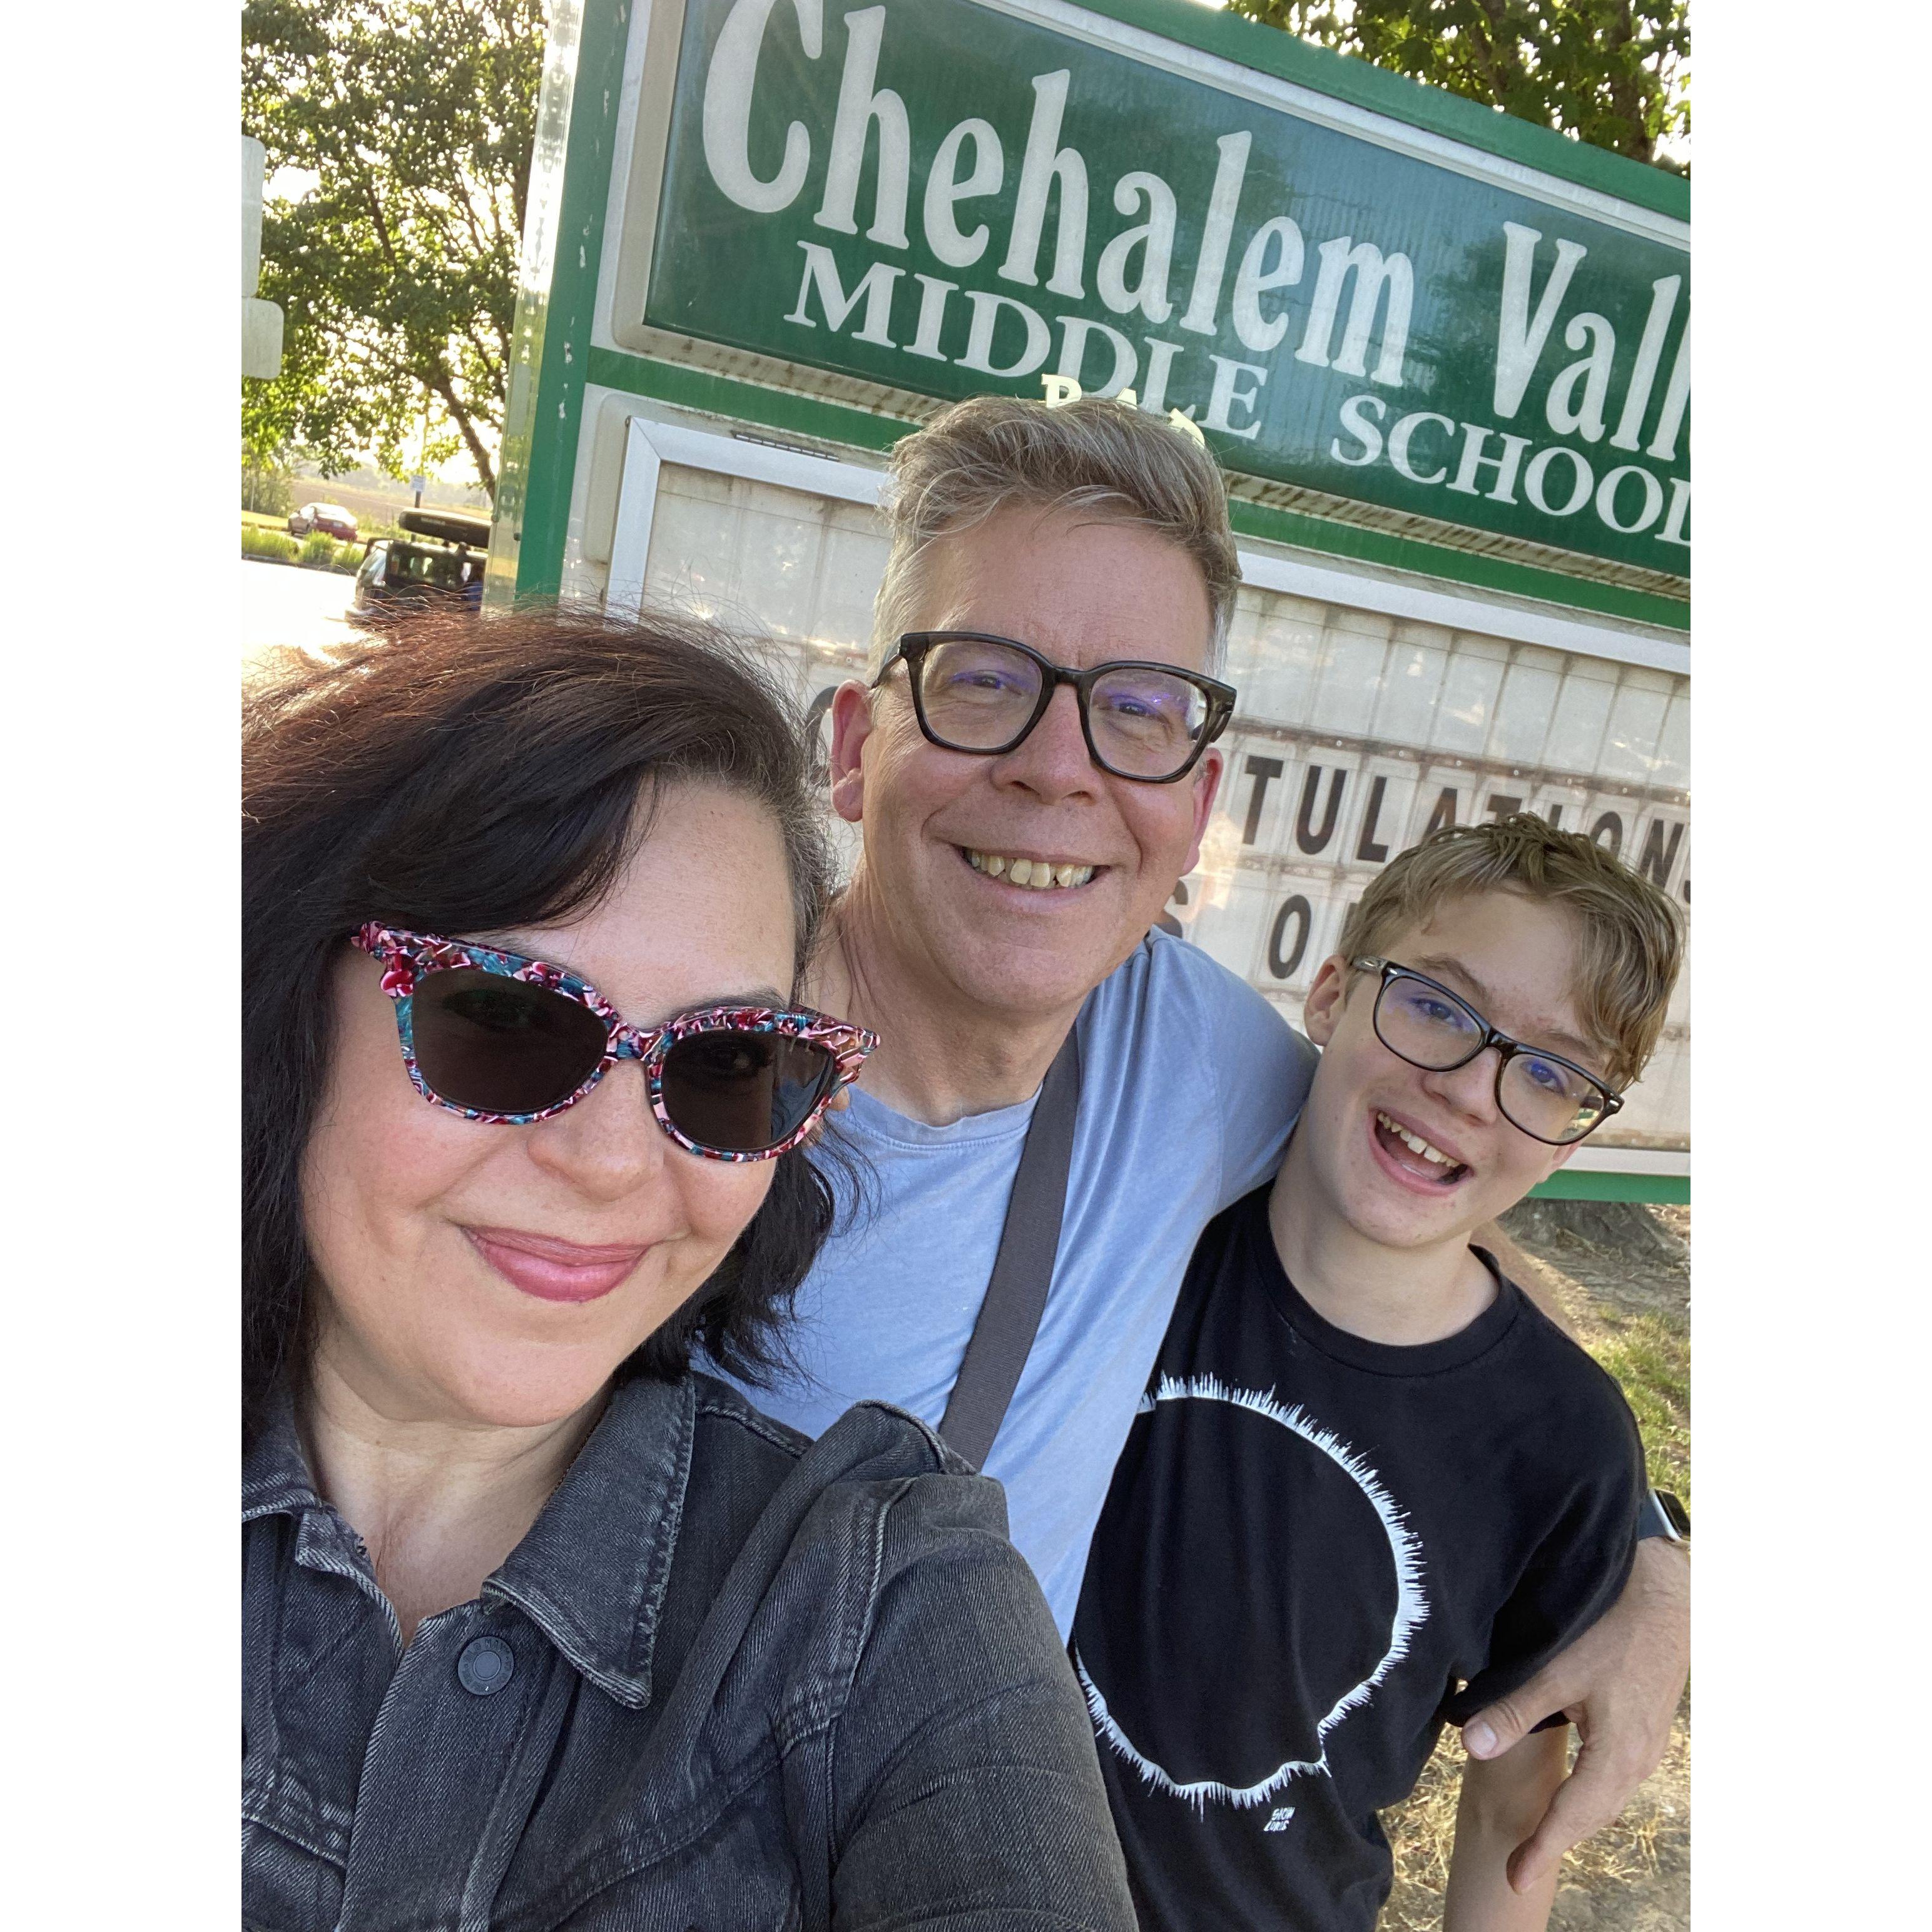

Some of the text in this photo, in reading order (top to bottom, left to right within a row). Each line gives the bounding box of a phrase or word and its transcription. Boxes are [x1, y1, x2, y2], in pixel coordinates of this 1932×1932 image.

[703, 0, 1691, 461] Chehalem Vall
[783, 240, 1268, 440] MIDDLE
[1330, 395, 1691, 547] SCHOOL
